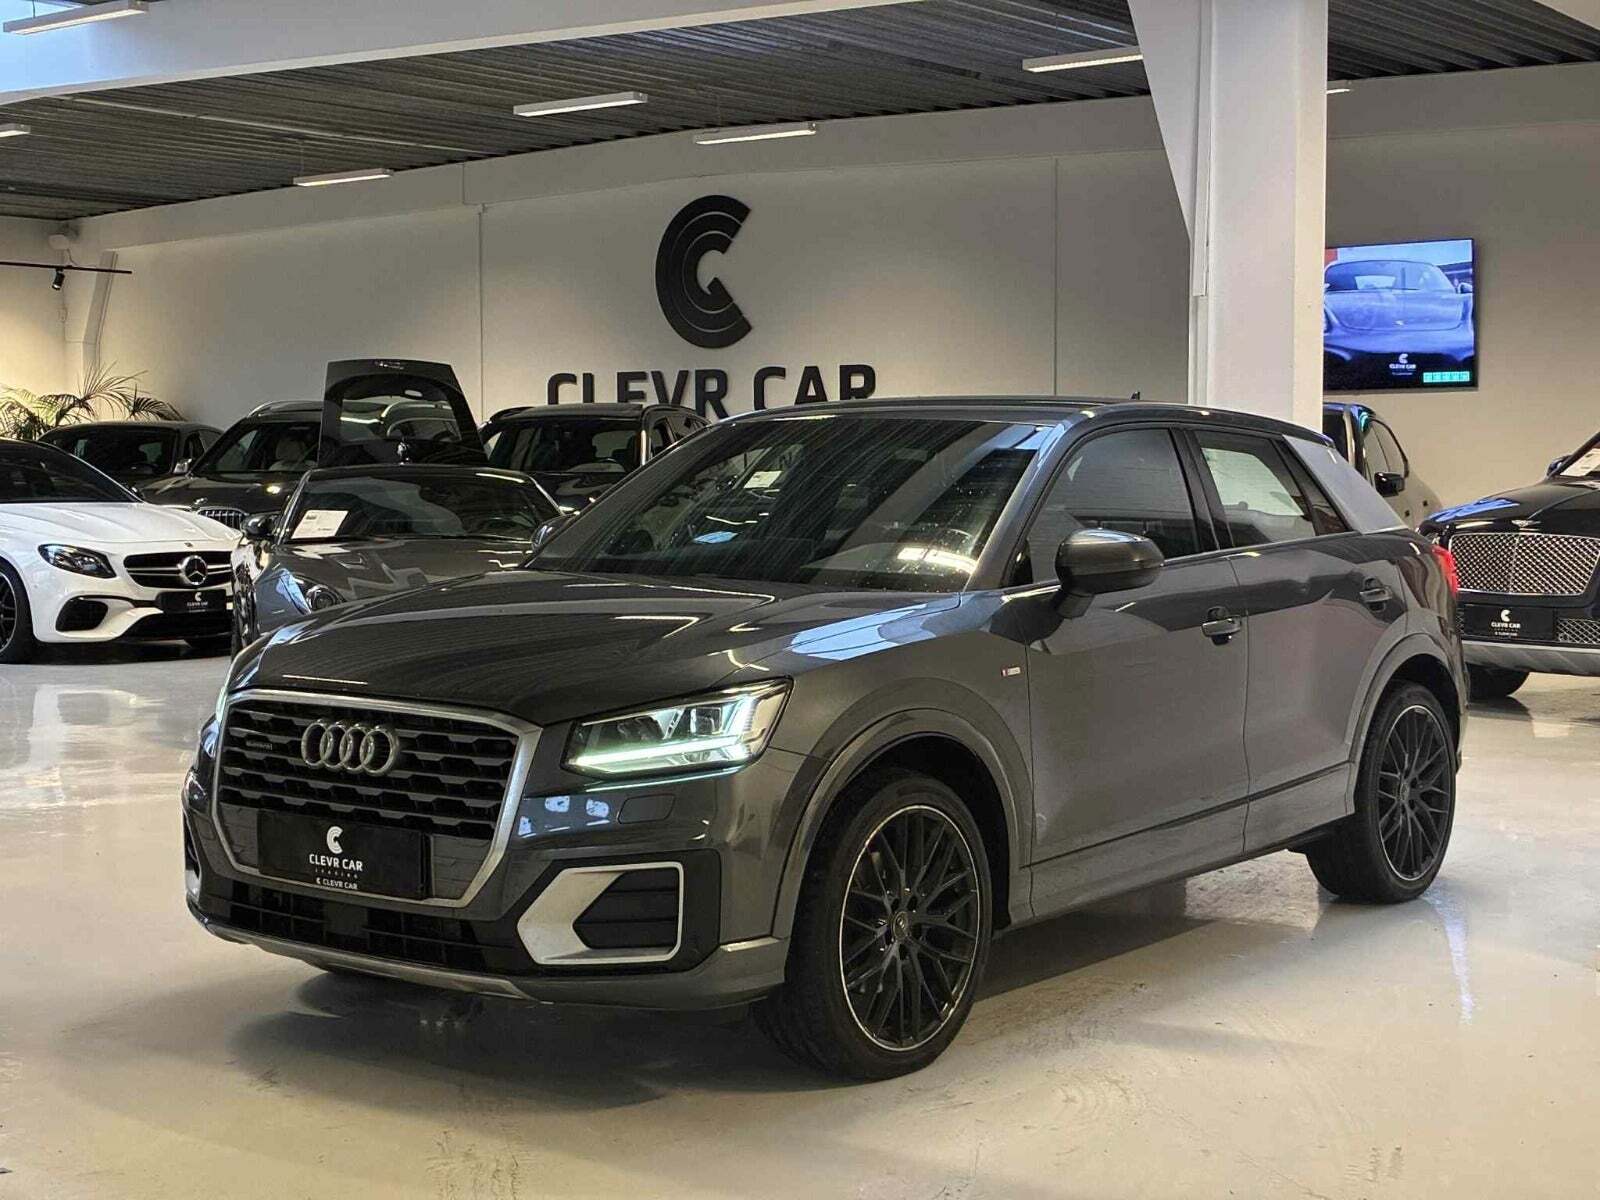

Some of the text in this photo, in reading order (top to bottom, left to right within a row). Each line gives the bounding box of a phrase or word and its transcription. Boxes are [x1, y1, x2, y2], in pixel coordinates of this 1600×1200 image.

[309, 853, 363, 871] CLEVR CAR
[322, 878, 358, 890] CLEVR CAR
